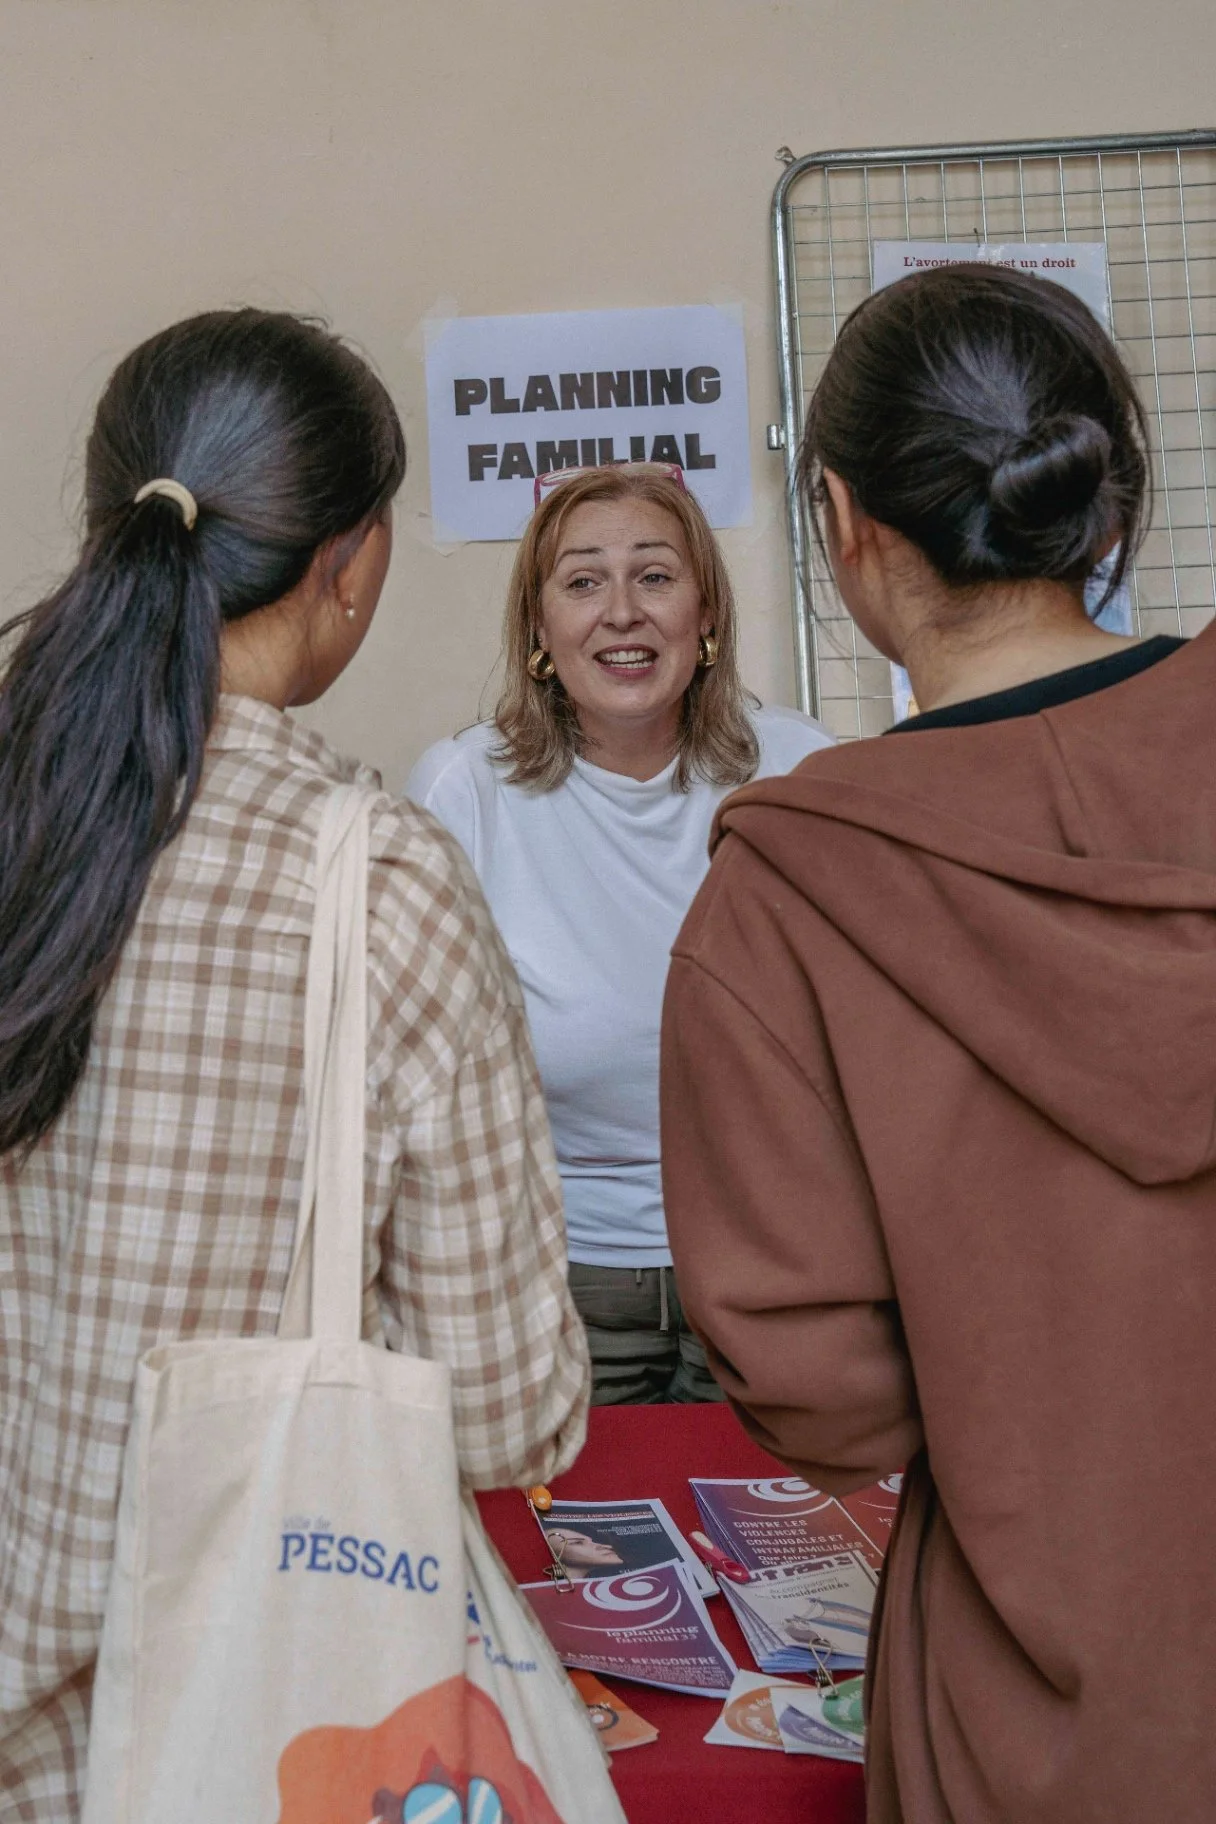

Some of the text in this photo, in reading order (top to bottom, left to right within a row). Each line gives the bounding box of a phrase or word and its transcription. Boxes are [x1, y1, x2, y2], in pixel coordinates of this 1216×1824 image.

[996, 259, 1017, 268] est
[1020, 259, 1038, 268] un
[1041, 256, 1076, 268] droit
[453, 365, 722, 416] PLANNING
[467, 432, 717, 482] FAMILIAL
[733, 1519, 808, 1529] CONTRE LES
[739, 1528, 808, 1537] VIOLENCES
[745, 1533, 844, 1547] CONJUGALES ET
[751, 1541, 865, 1555] INTRAFAMILIALES
[277, 1532, 441, 1594] PESSAC
[622, 1624, 700, 1639] planning
[615, 1634, 679, 1644] familial
[630, 1655, 720, 1666] RENCONTRE
